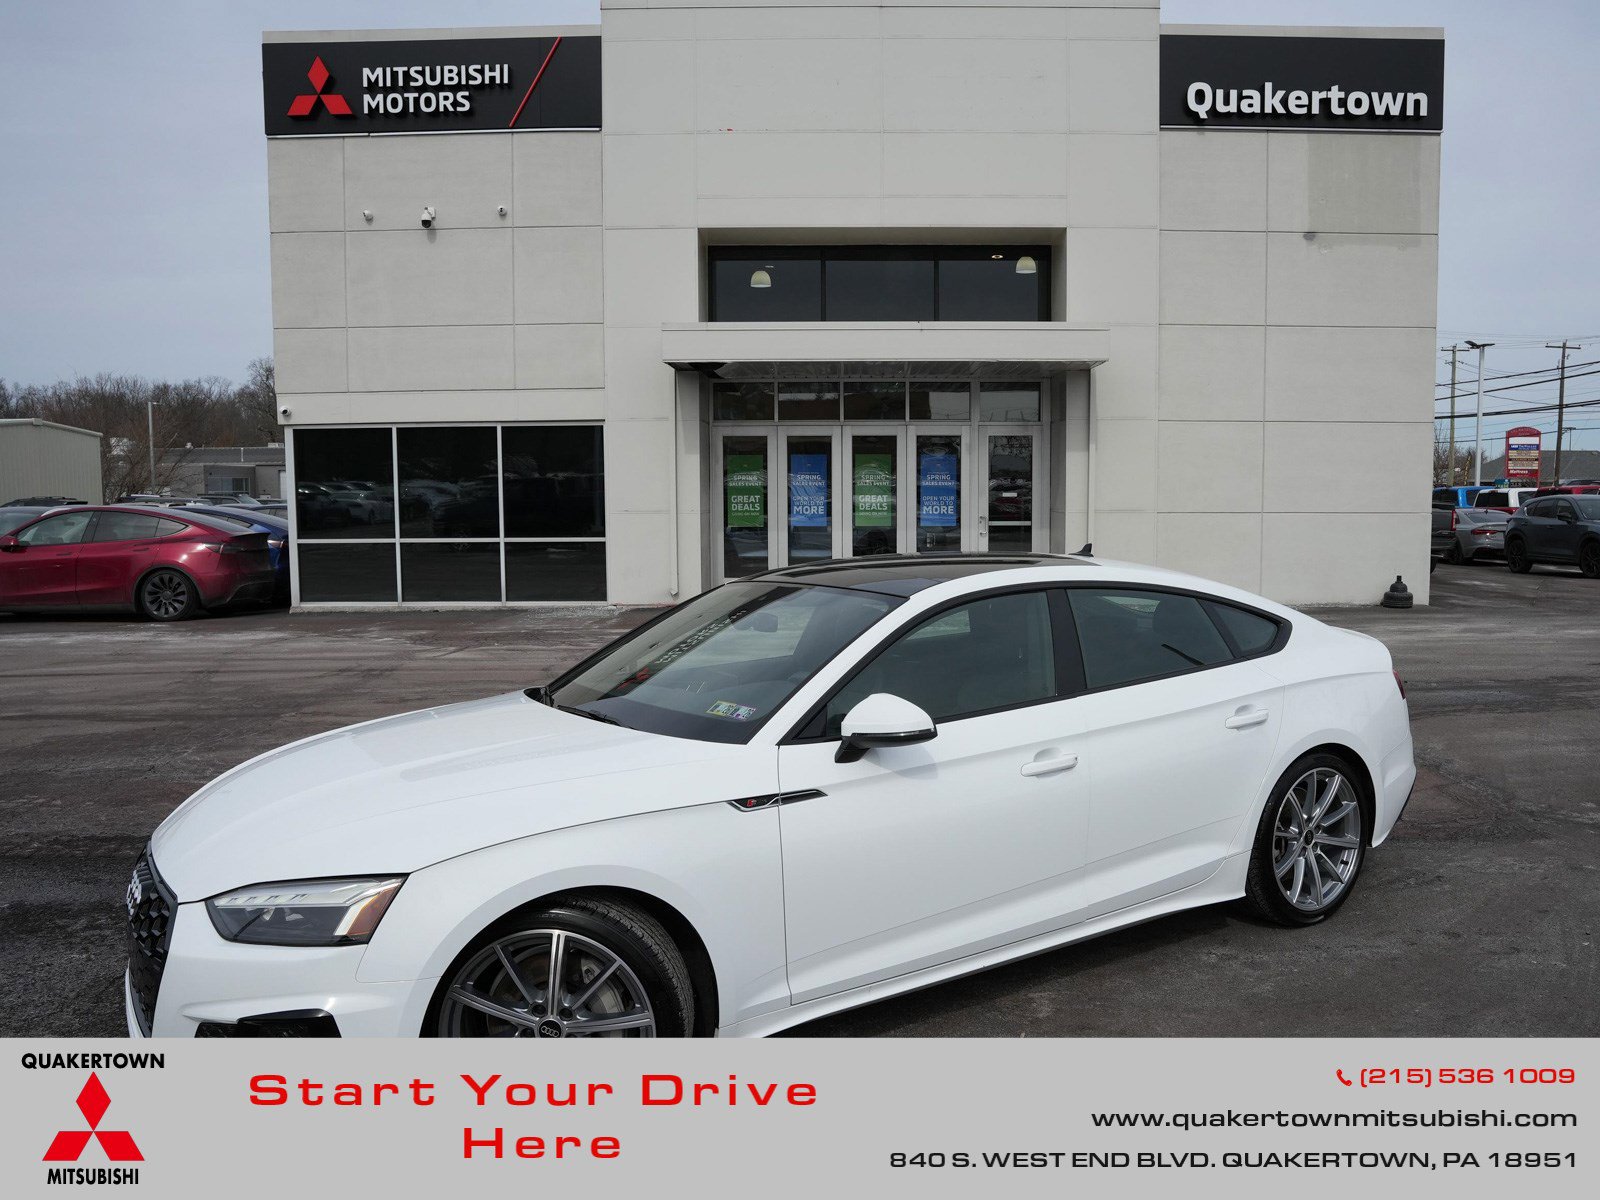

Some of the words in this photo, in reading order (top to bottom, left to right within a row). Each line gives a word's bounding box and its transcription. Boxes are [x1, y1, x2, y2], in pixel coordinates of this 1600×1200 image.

[362, 63, 509, 88] MITSUBISHI
[363, 91, 471, 114] MOTORS
[1187, 81, 1428, 119] Quakertown
[731, 495, 761, 503] GREAT
[858, 494, 888, 502] GREAT
[731, 503, 761, 511] DEALS
[793, 506, 825, 515] MORE
[922, 505, 954, 514] MORE
